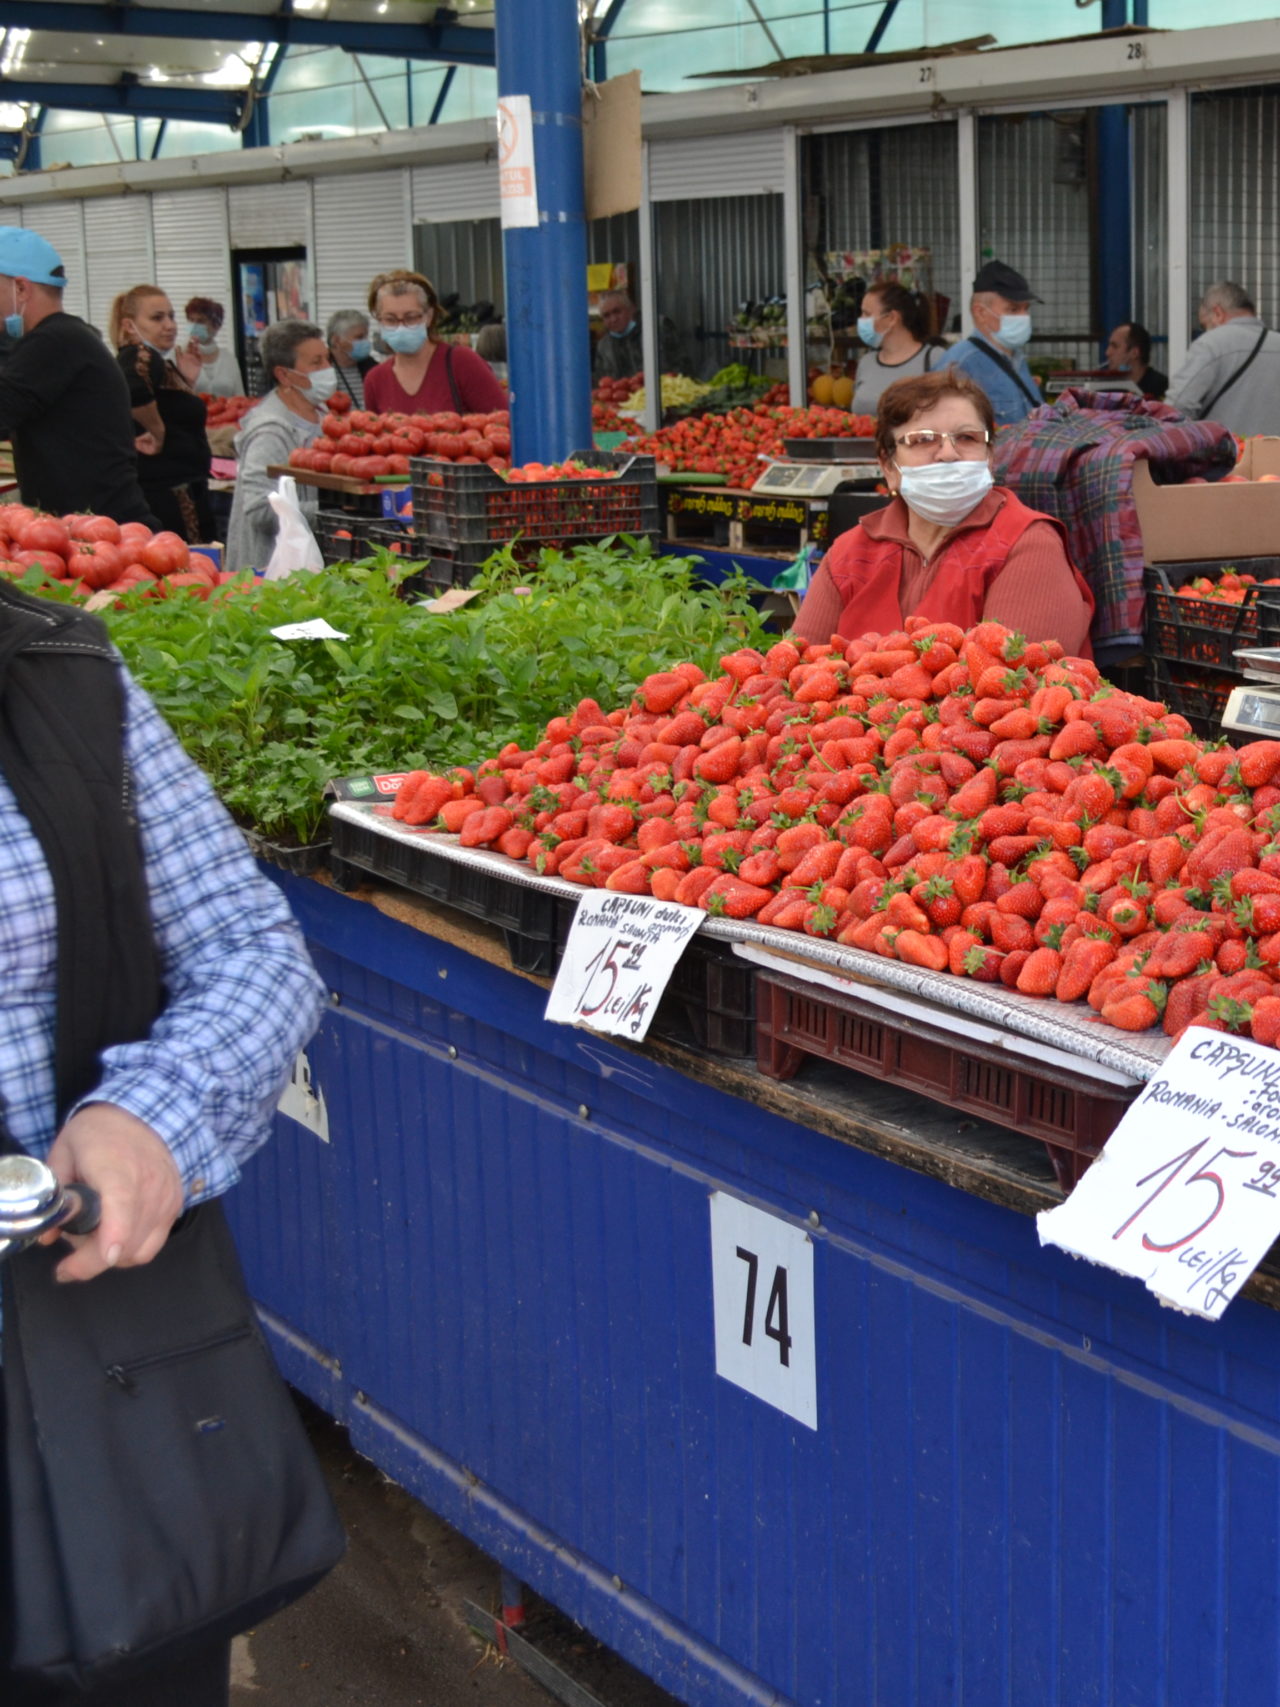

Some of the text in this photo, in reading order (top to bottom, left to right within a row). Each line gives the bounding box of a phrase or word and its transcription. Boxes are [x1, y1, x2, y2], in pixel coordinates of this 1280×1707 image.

[920, 66, 932, 83] 27
[1127, 43, 1142, 60] 28
[574, 937, 647, 1017] 15 99
[1112, 1136, 1257, 1252] 15
[736, 1245, 792, 1368] 74
